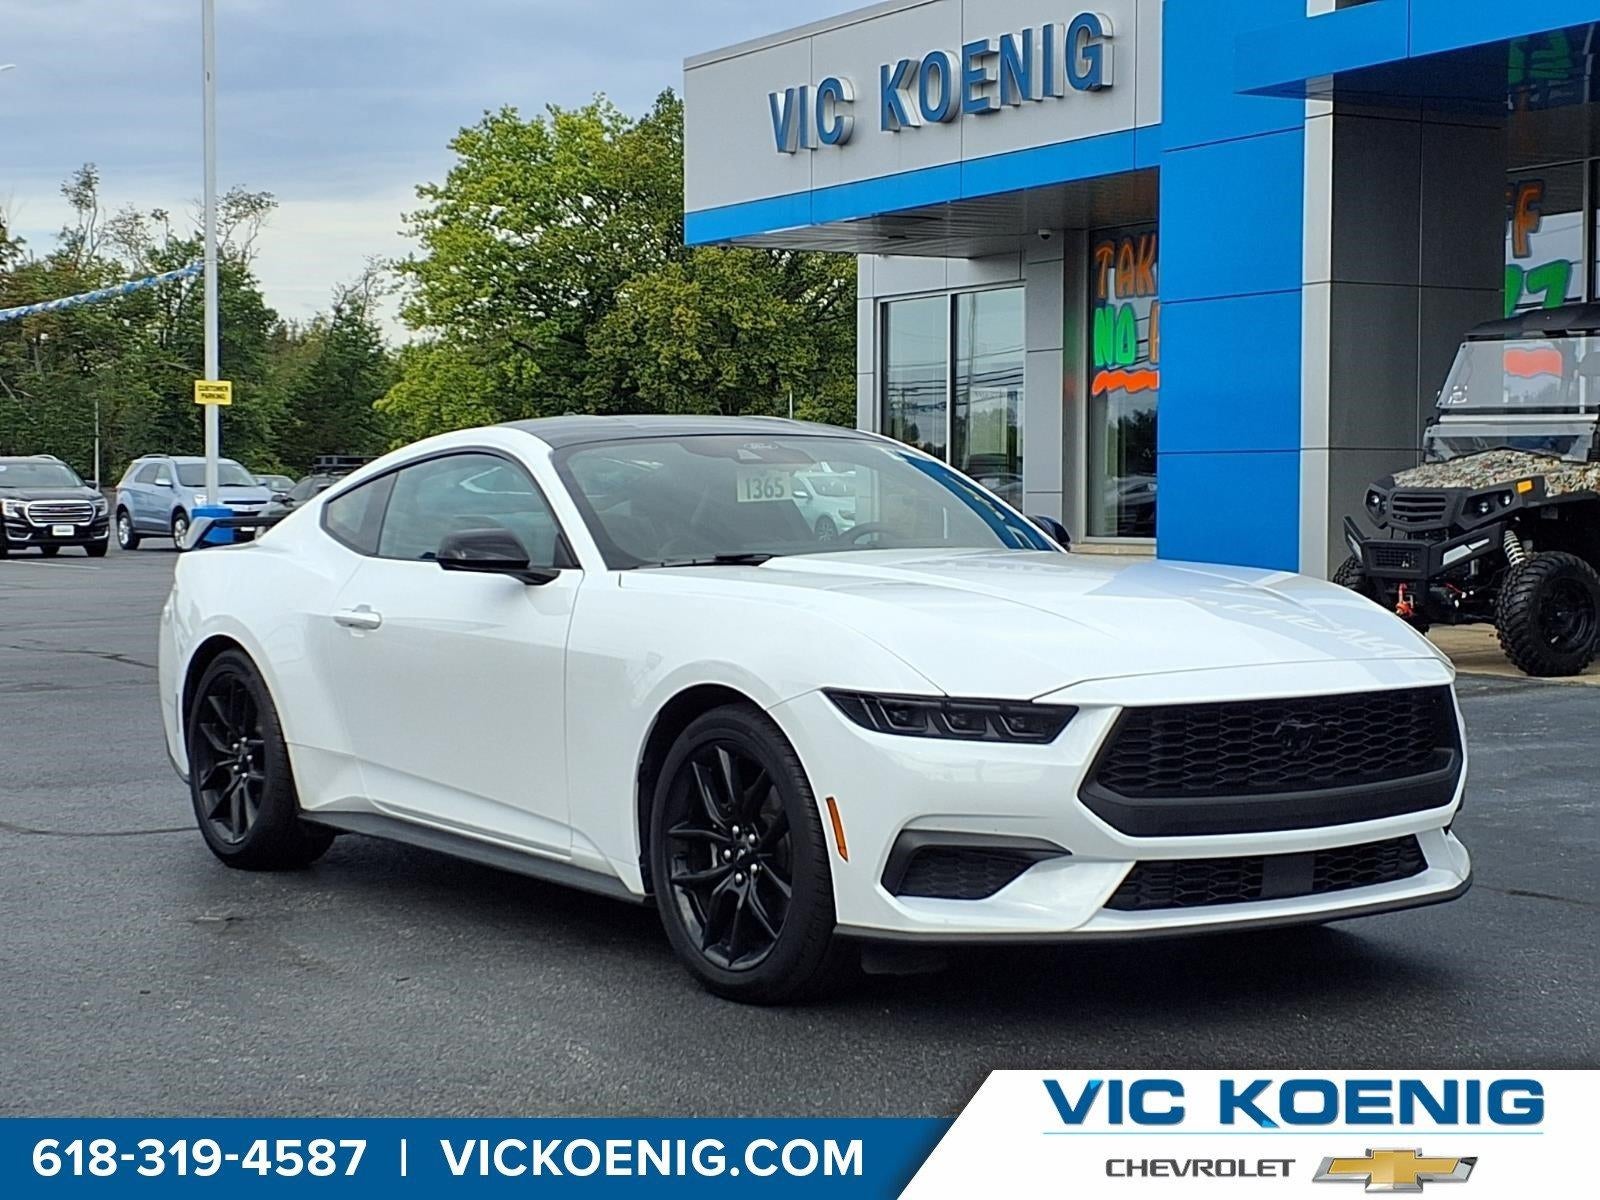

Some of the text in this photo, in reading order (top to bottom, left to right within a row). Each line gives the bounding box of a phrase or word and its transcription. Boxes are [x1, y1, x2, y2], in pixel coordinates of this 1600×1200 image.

[768, 12, 1114, 153] VIC KOENIG
[1093, 302, 1137, 368] NO
[745, 477, 785, 500] 1365
